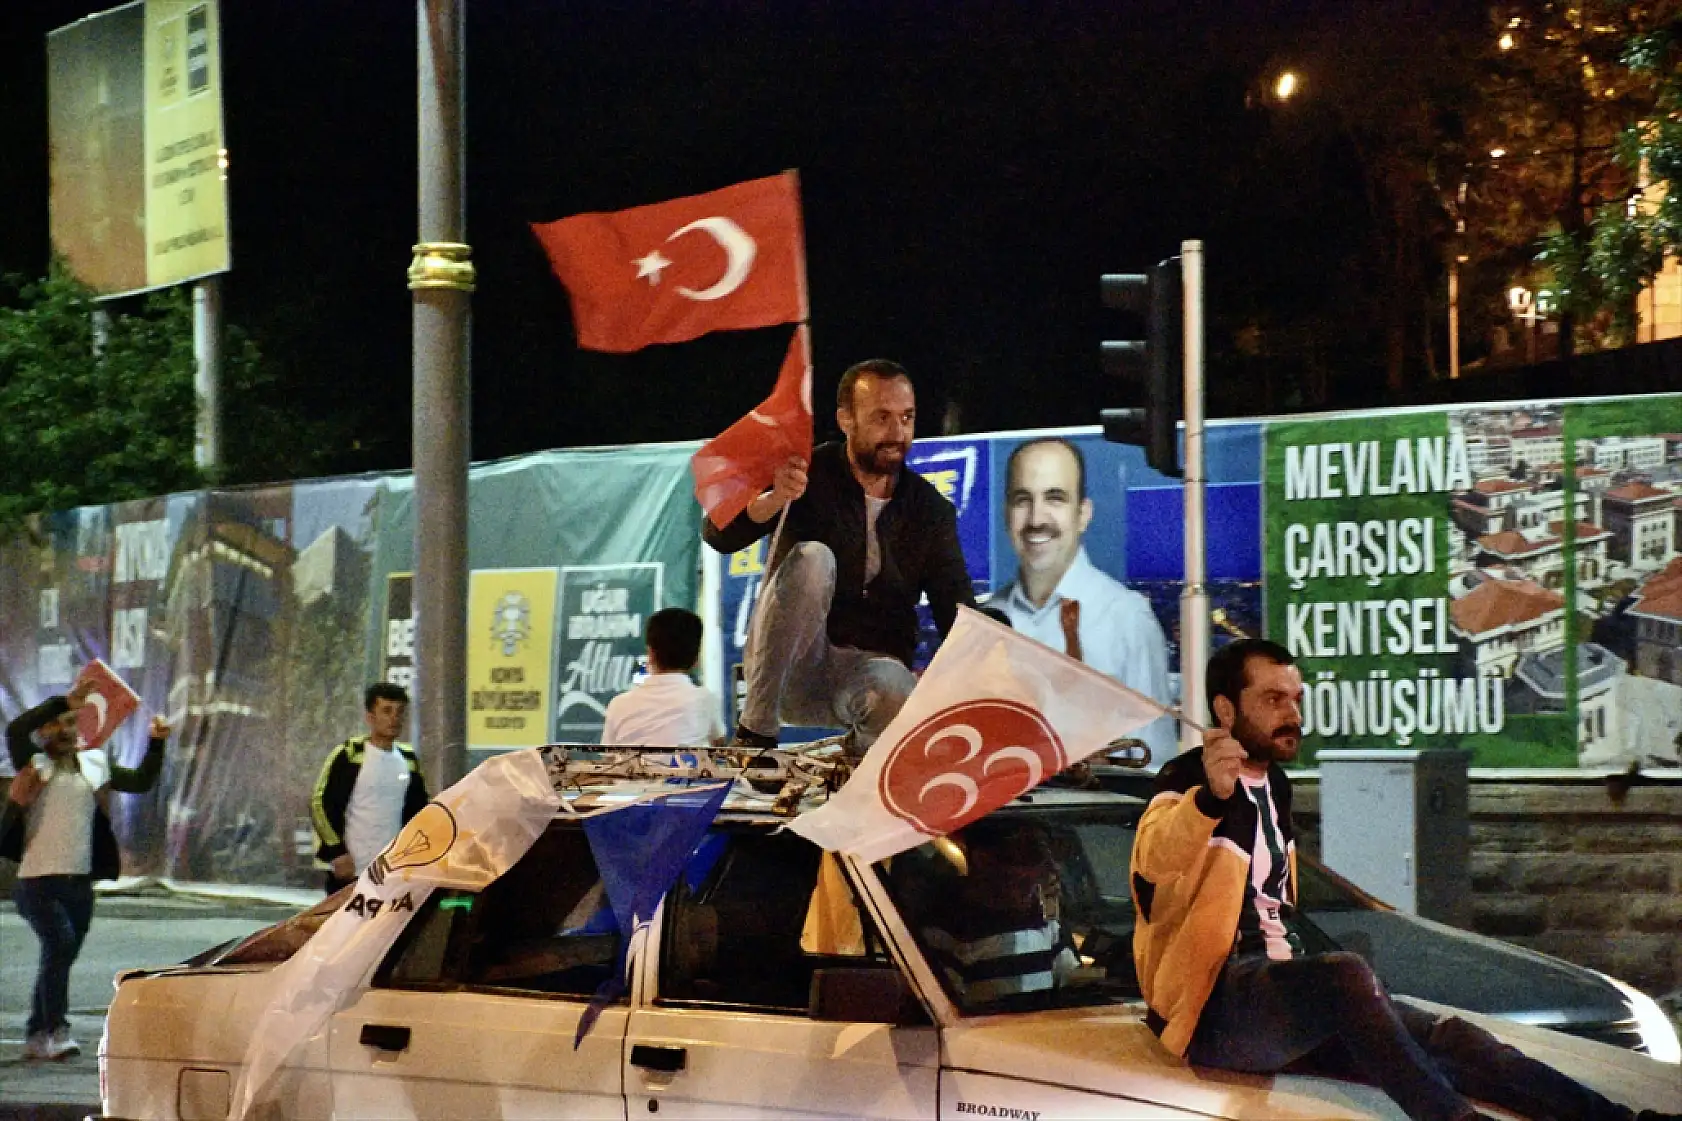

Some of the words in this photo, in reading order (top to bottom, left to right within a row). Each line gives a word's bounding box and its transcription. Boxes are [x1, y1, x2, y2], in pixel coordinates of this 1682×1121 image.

[1285, 429, 1472, 501] MEVLANA
[1284, 517, 1436, 589] ÇARŞISI
[1286, 597, 1460, 658] KENTSEL
[956, 1102, 1041, 1121] BROADWAY
